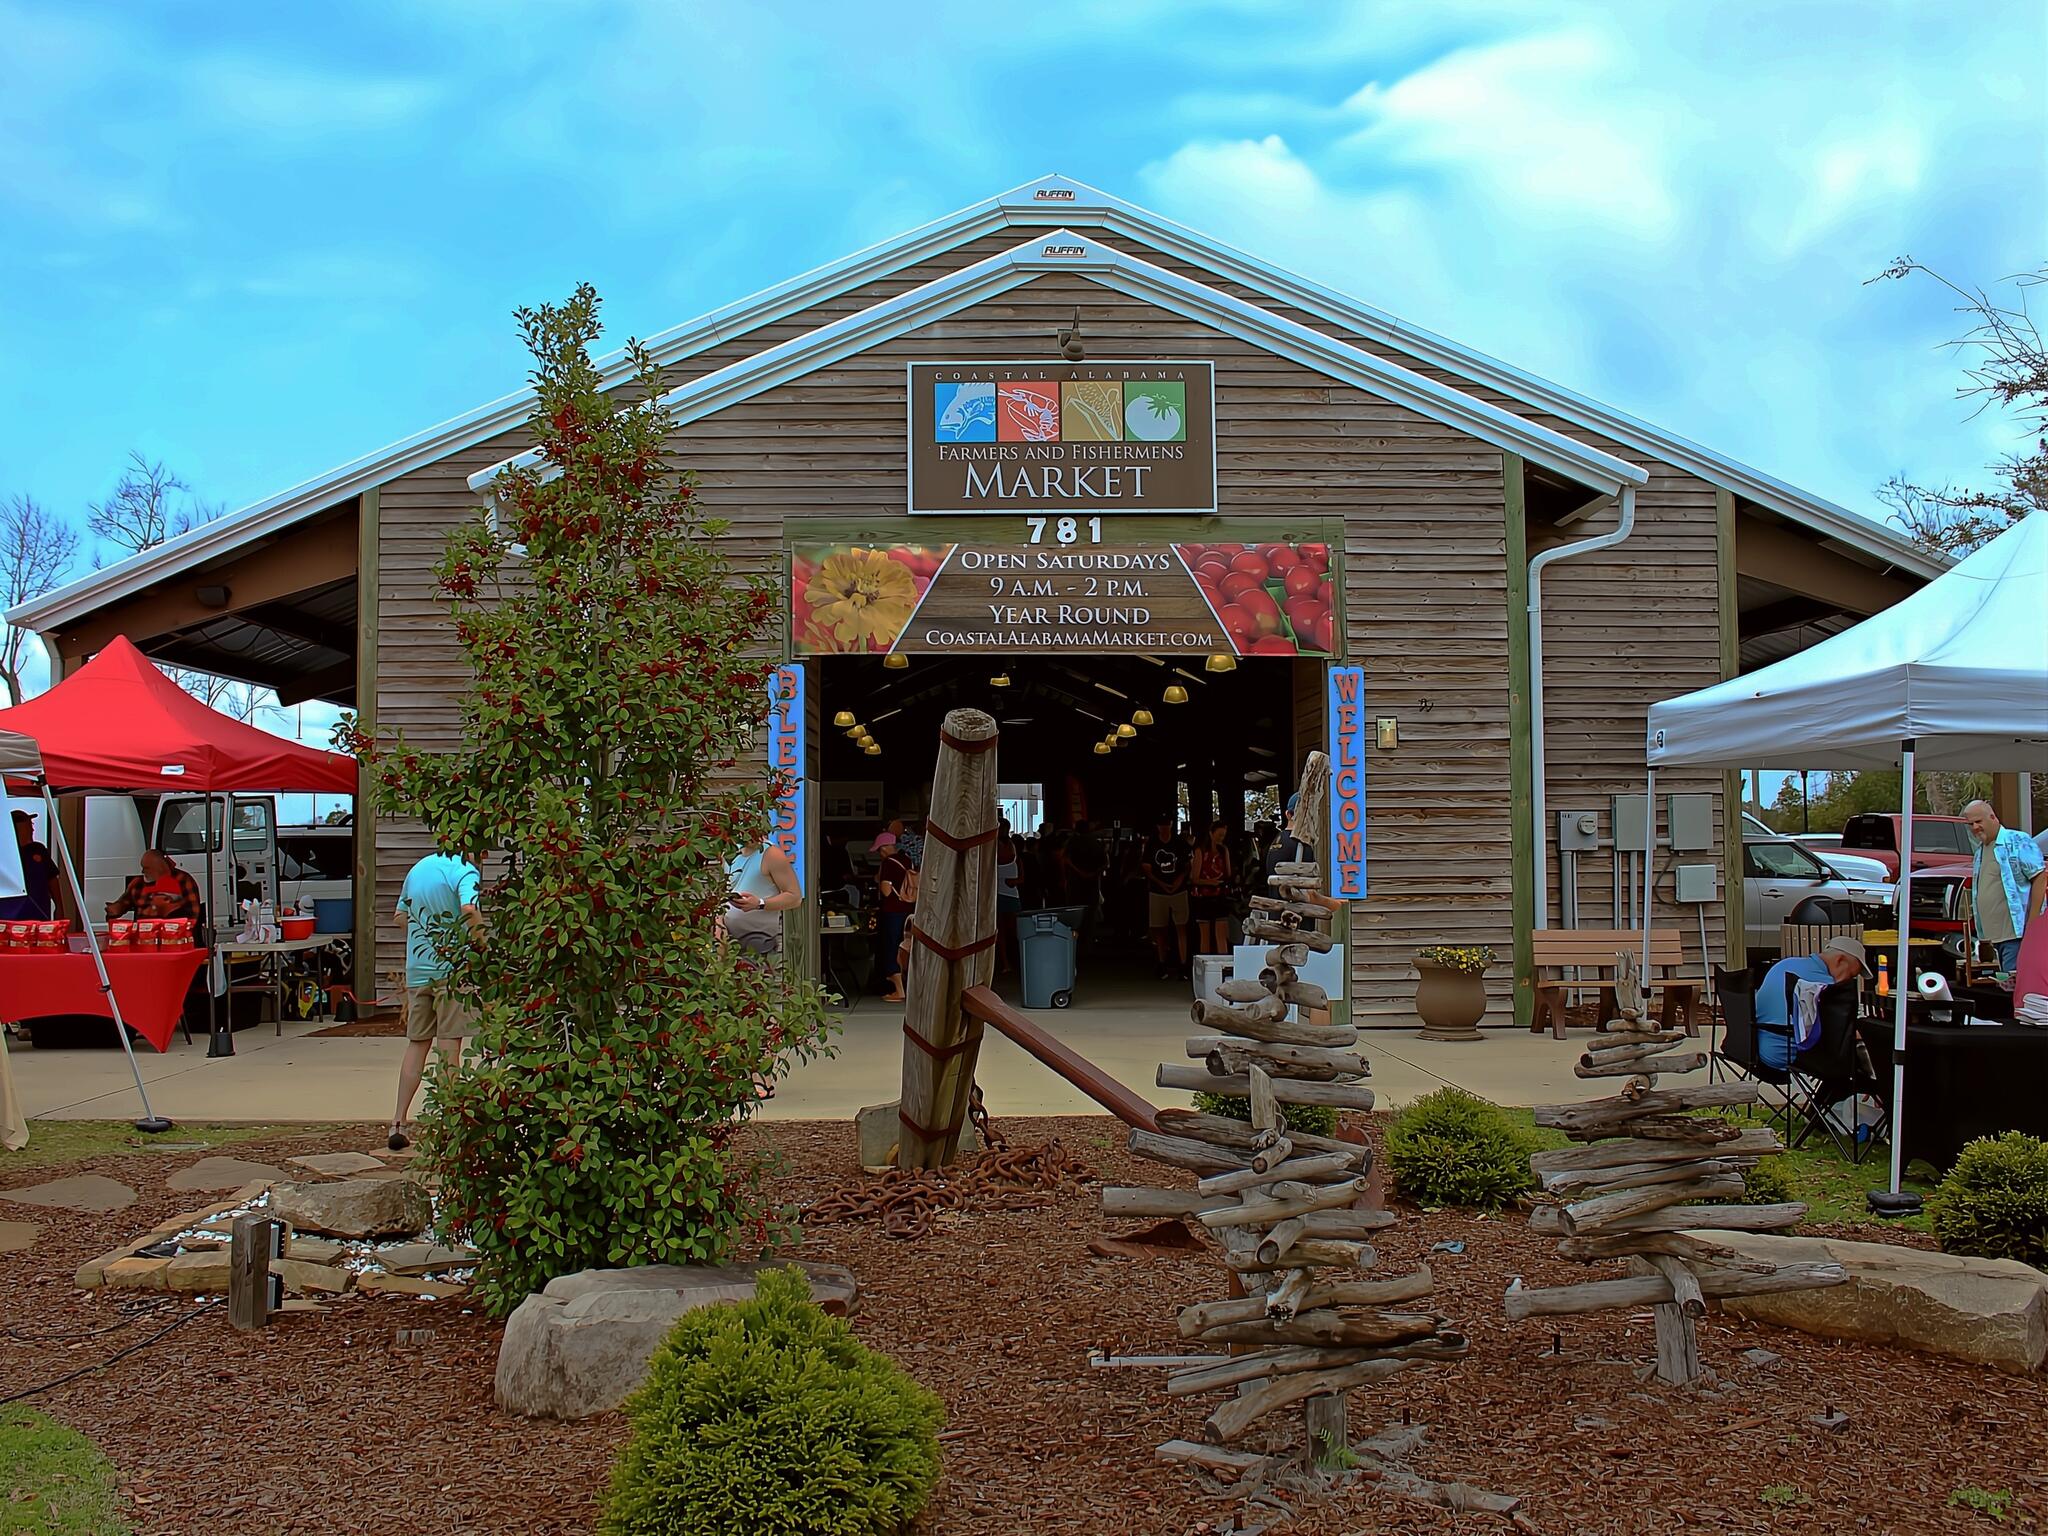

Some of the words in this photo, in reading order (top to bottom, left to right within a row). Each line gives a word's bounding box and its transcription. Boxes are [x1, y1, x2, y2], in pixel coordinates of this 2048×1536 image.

[1036, 190, 1073, 198] RUFFIN
[1044, 246, 1085, 254] RUFFIN
[935, 371, 1047, 380] COASTAL
[1070, 371, 1184, 379] ALABAMA
[939, 445, 1018, 461] FARMERS
[1024, 446, 1065, 460] AND
[1072, 444, 1184, 460] FISHERMENS
[962, 461, 1152, 499] MARKET
[1027, 517, 1102, 544] 781
[961, 551, 1028, 569] OPEN
[1037, 552, 1170, 570] SATURDAYS
[990, 577, 1004, 597] 9
[1010, 579, 1059, 597] A.M.
[1084, 577, 1098, 597] 2
[1107, 579, 1149, 597] P.M.
[988, 604, 1051, 624] YEAR
[1058, 604, 1150, 625] ROUND
[1333, 673, 1362, 894] WELCOME
